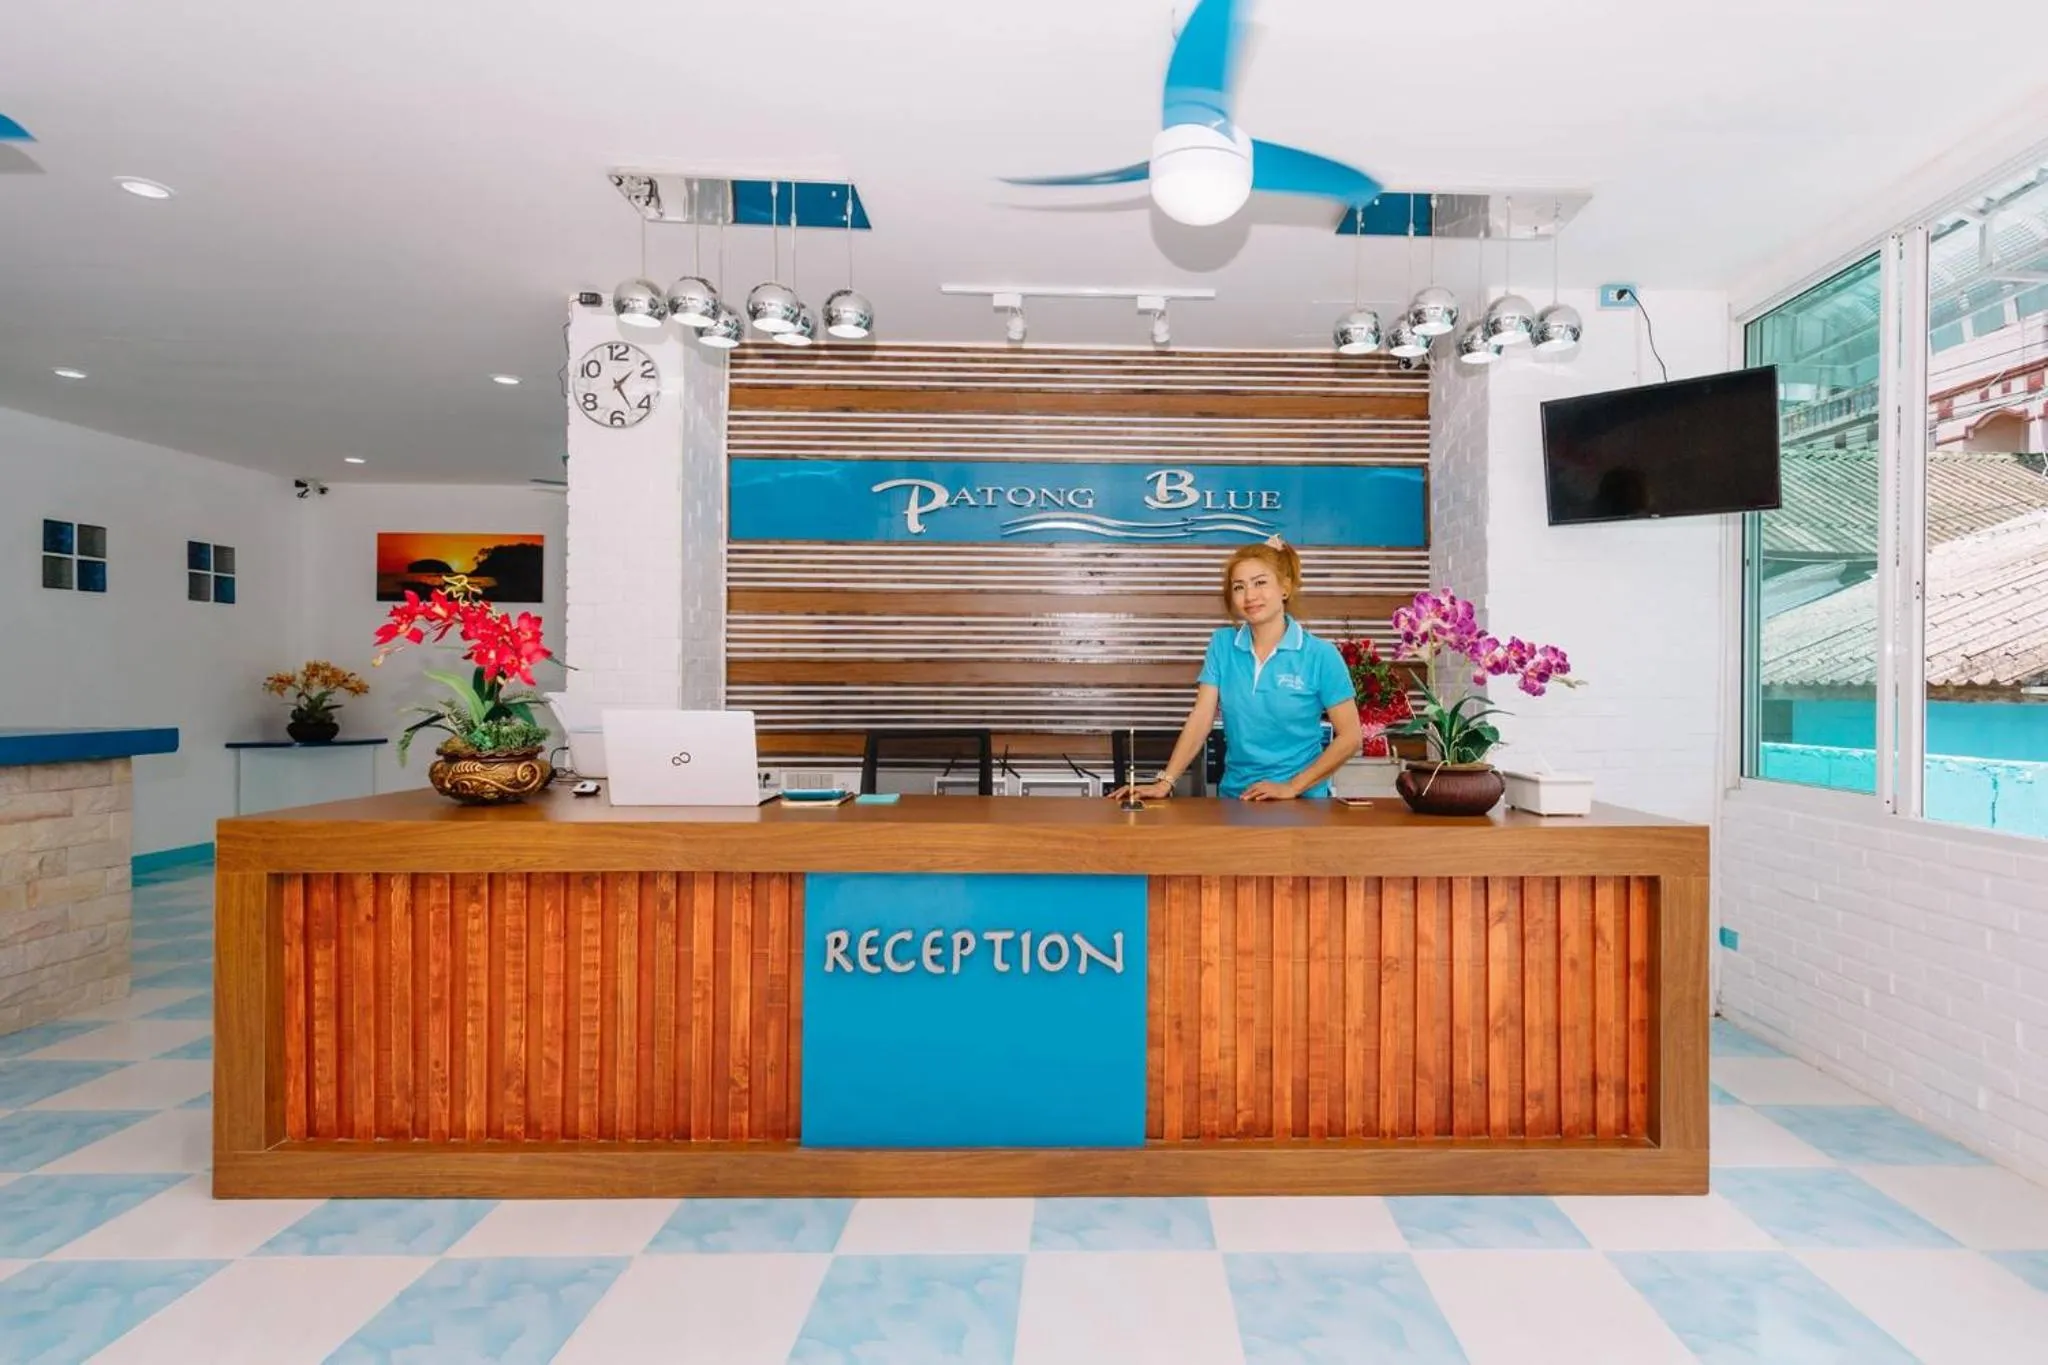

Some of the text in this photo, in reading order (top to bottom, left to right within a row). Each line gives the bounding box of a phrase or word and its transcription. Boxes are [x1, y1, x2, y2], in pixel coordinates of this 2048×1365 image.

[607, 345, 629, 361] 12
[581, 360, 601, 378] 10
[641, 360, 655, 378] 2
[583, 393, 598, 410] 8
[638, 395, 650, 409] 4
[610, 411, 625, 426] 6
[871, 469, 1282, 534] PATONG BLUE
[824, 928, 1125, 975] RECEPTION
